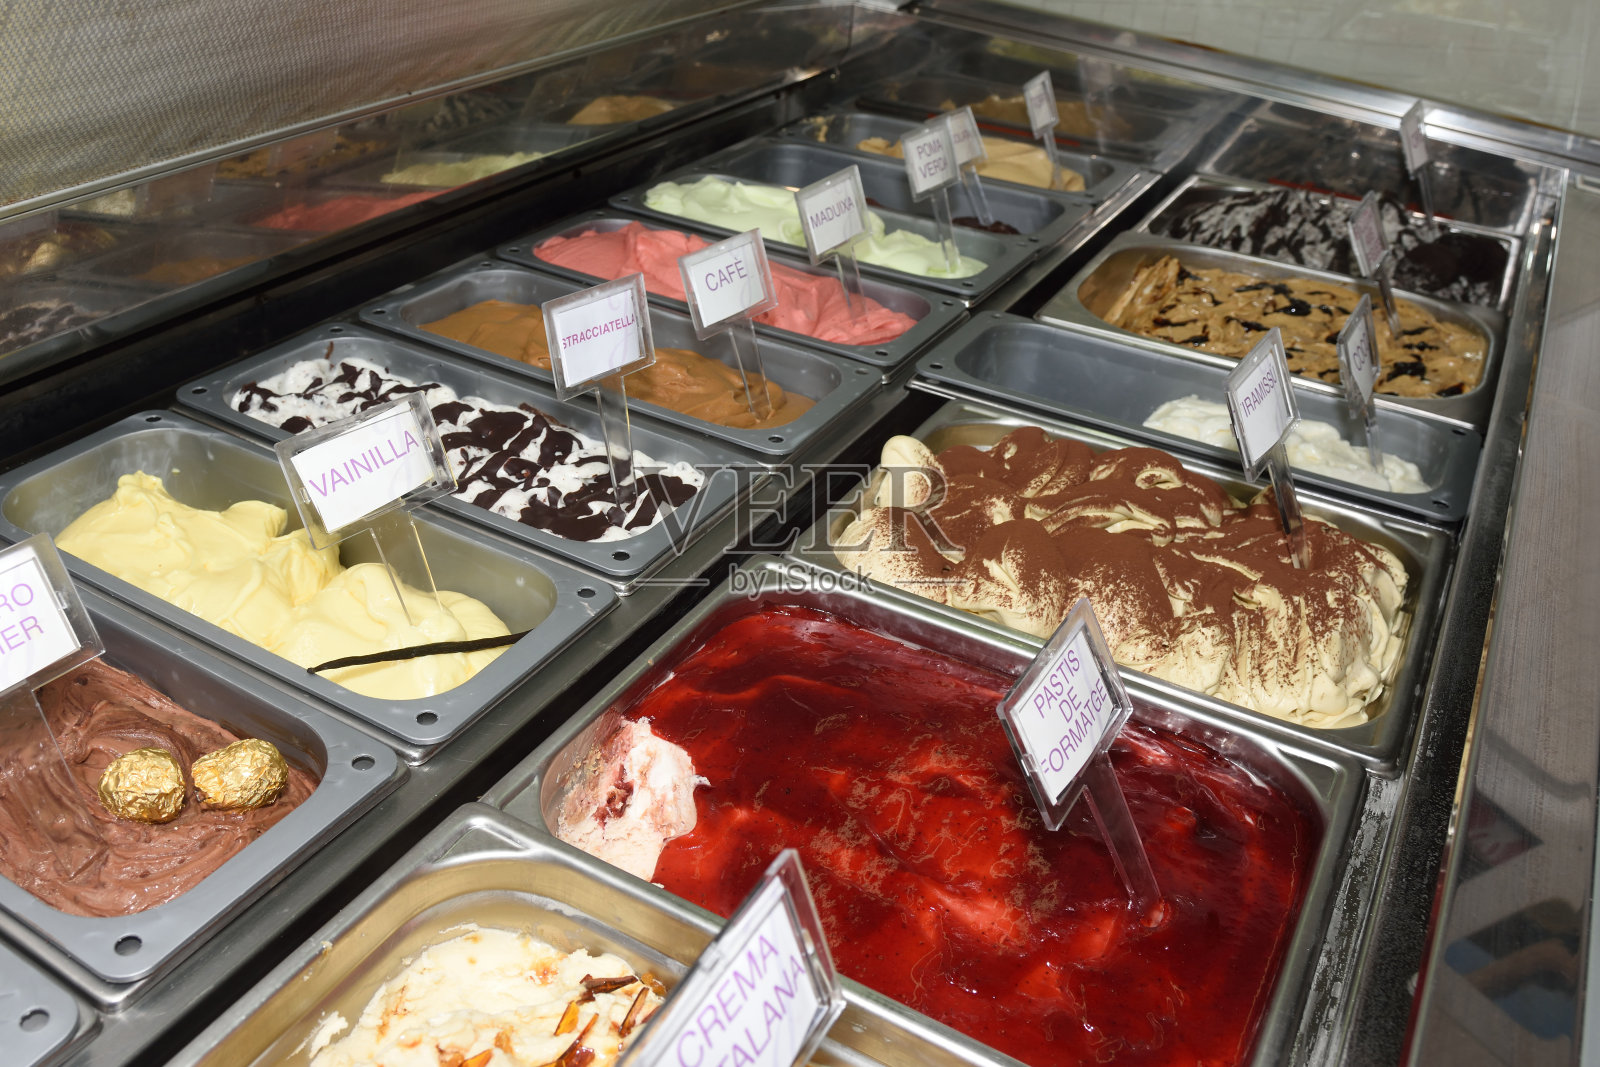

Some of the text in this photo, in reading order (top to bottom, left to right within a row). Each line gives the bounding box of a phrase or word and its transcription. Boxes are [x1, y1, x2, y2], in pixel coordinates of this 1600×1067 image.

[916, 138, 943, 159] POMA
[810, 196, 853, 229] MADUIXA
[705, 256, 748, 291] CAFÈ
[309, 430, 419, 496] VAINILLA
[0, 615, 44, 655] ER
[1033, 649, 1081, 719] PASTIS
[1059, 686, 1082, 723] DE
[677, 935, 779, 1067] CREMA
[718, 955, 806, 1067] ALANA
